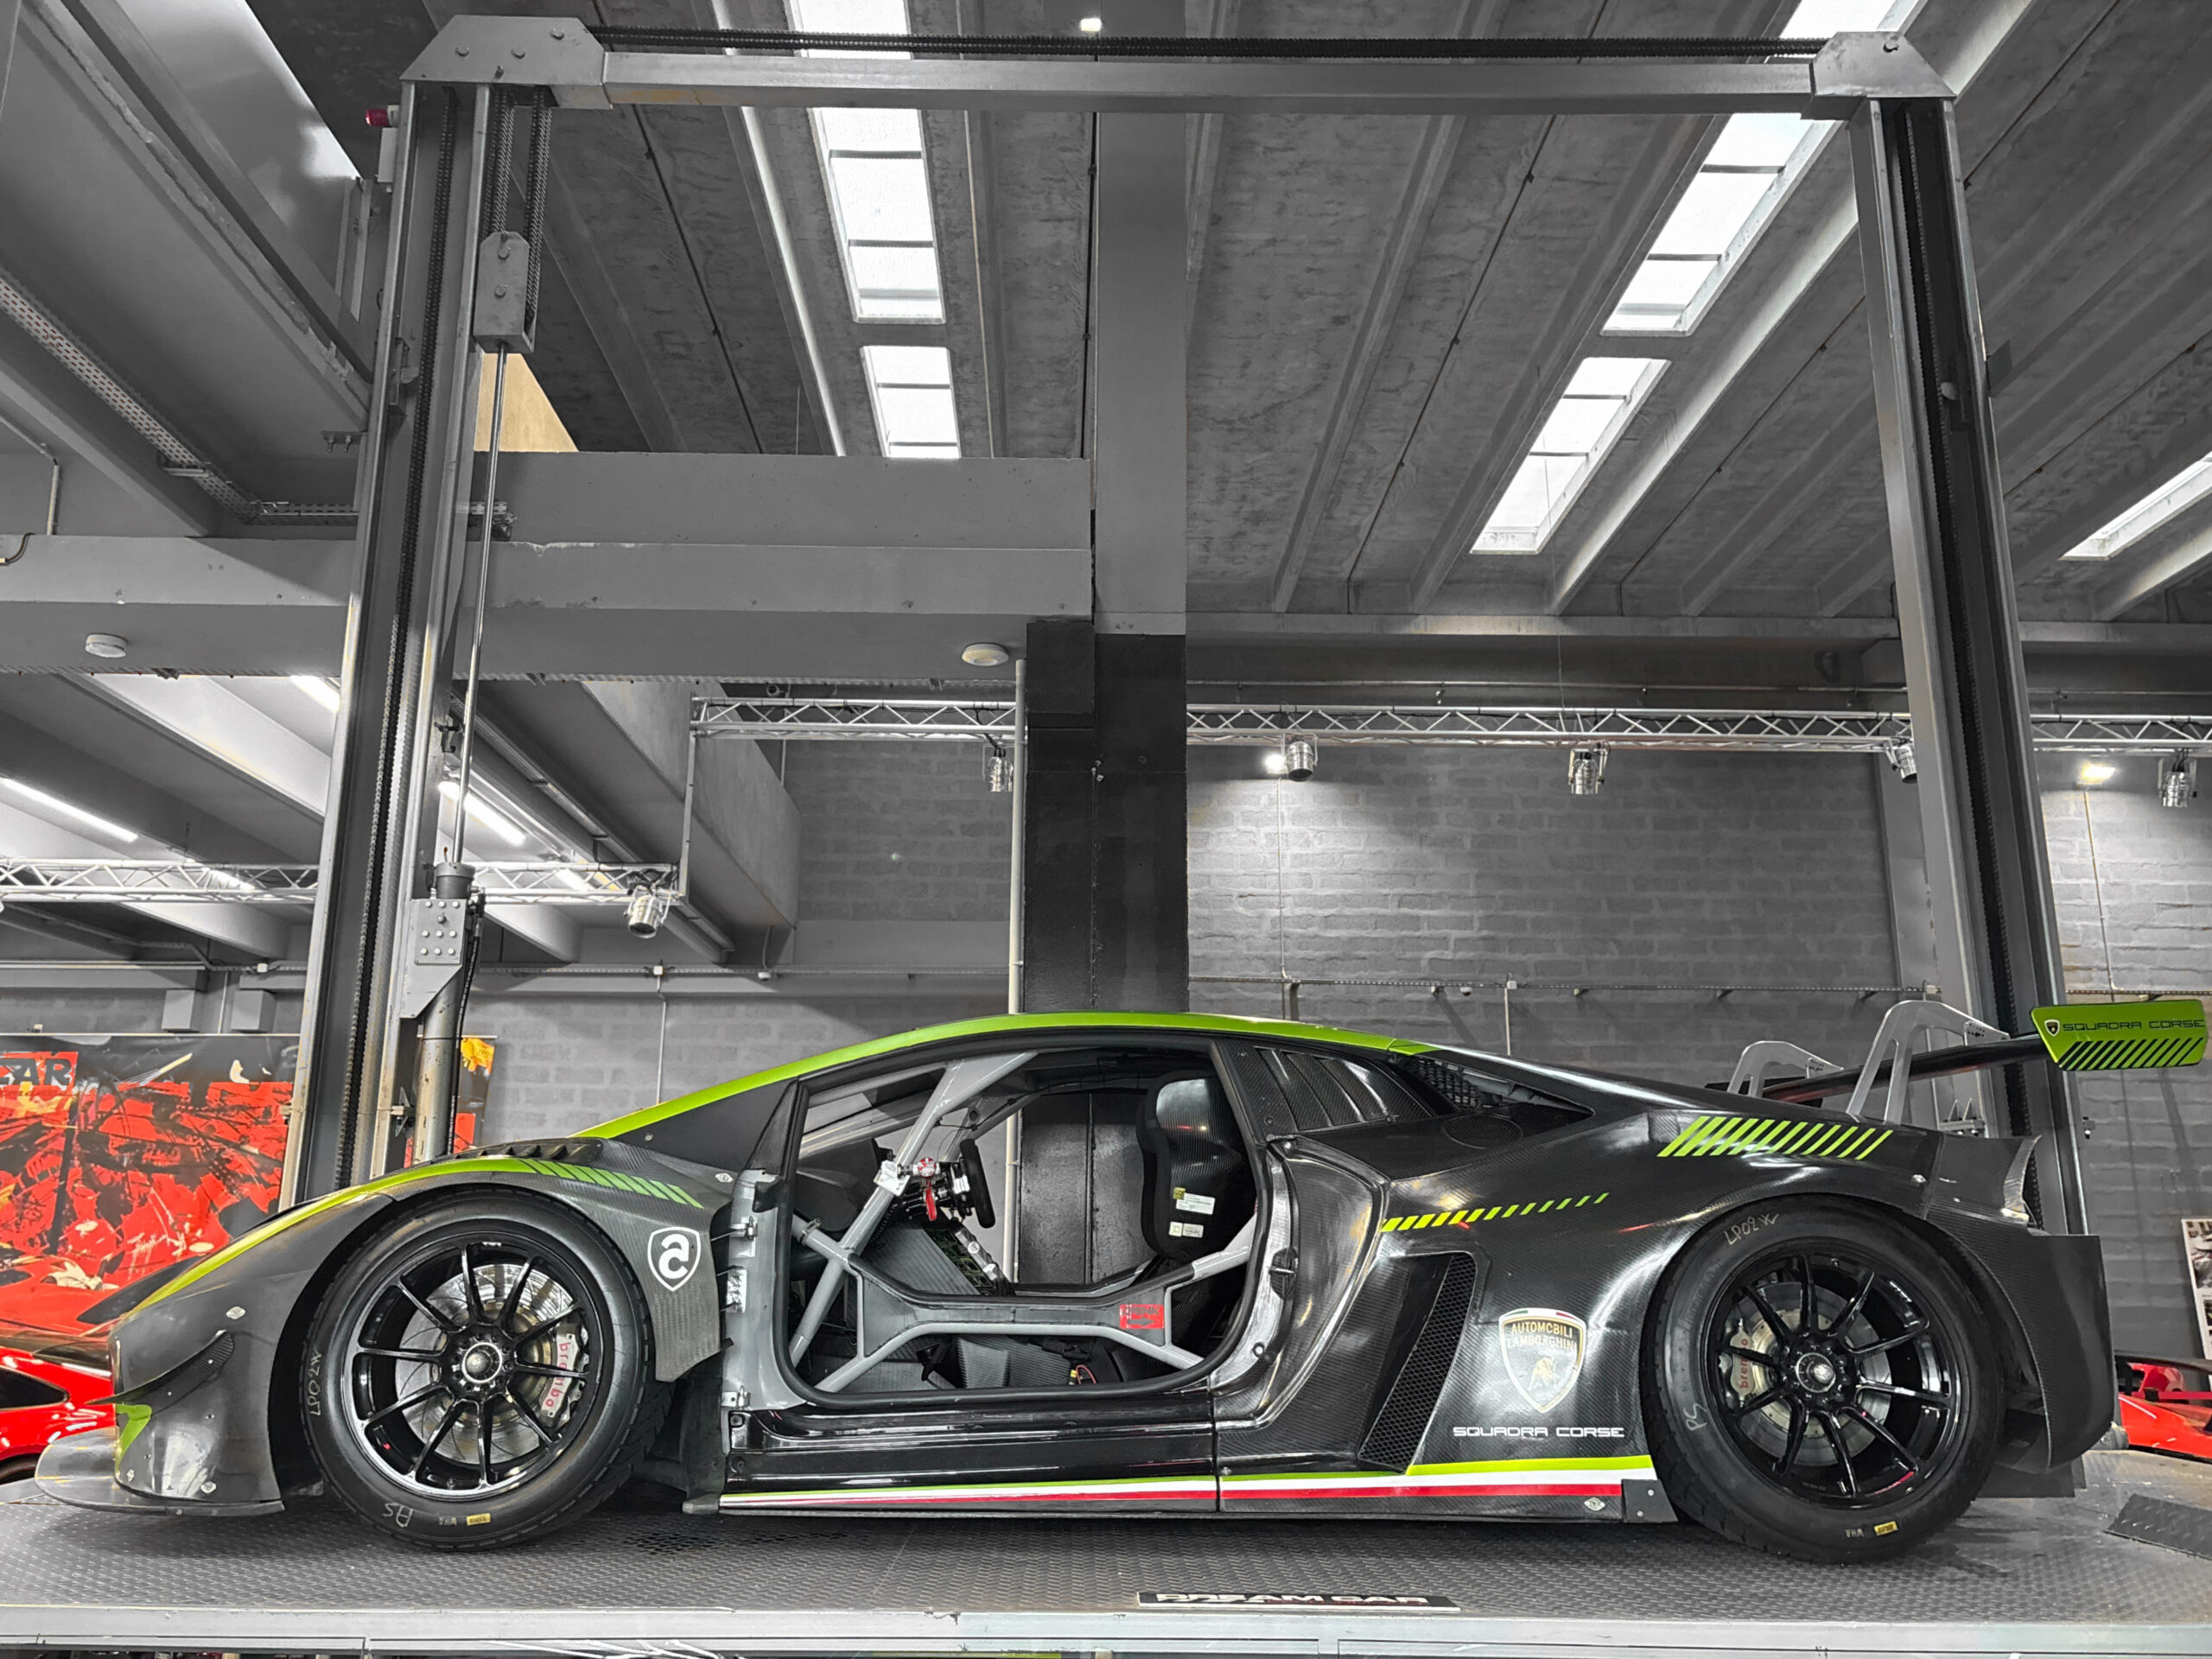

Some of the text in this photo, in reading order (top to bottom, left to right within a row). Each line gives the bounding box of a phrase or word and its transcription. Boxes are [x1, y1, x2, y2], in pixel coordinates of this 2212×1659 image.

[2063, 1020, 2205, 1032] SQUADRA CORSE
[1453, 1426, 1625, 1438] SQUADRA CORSE
